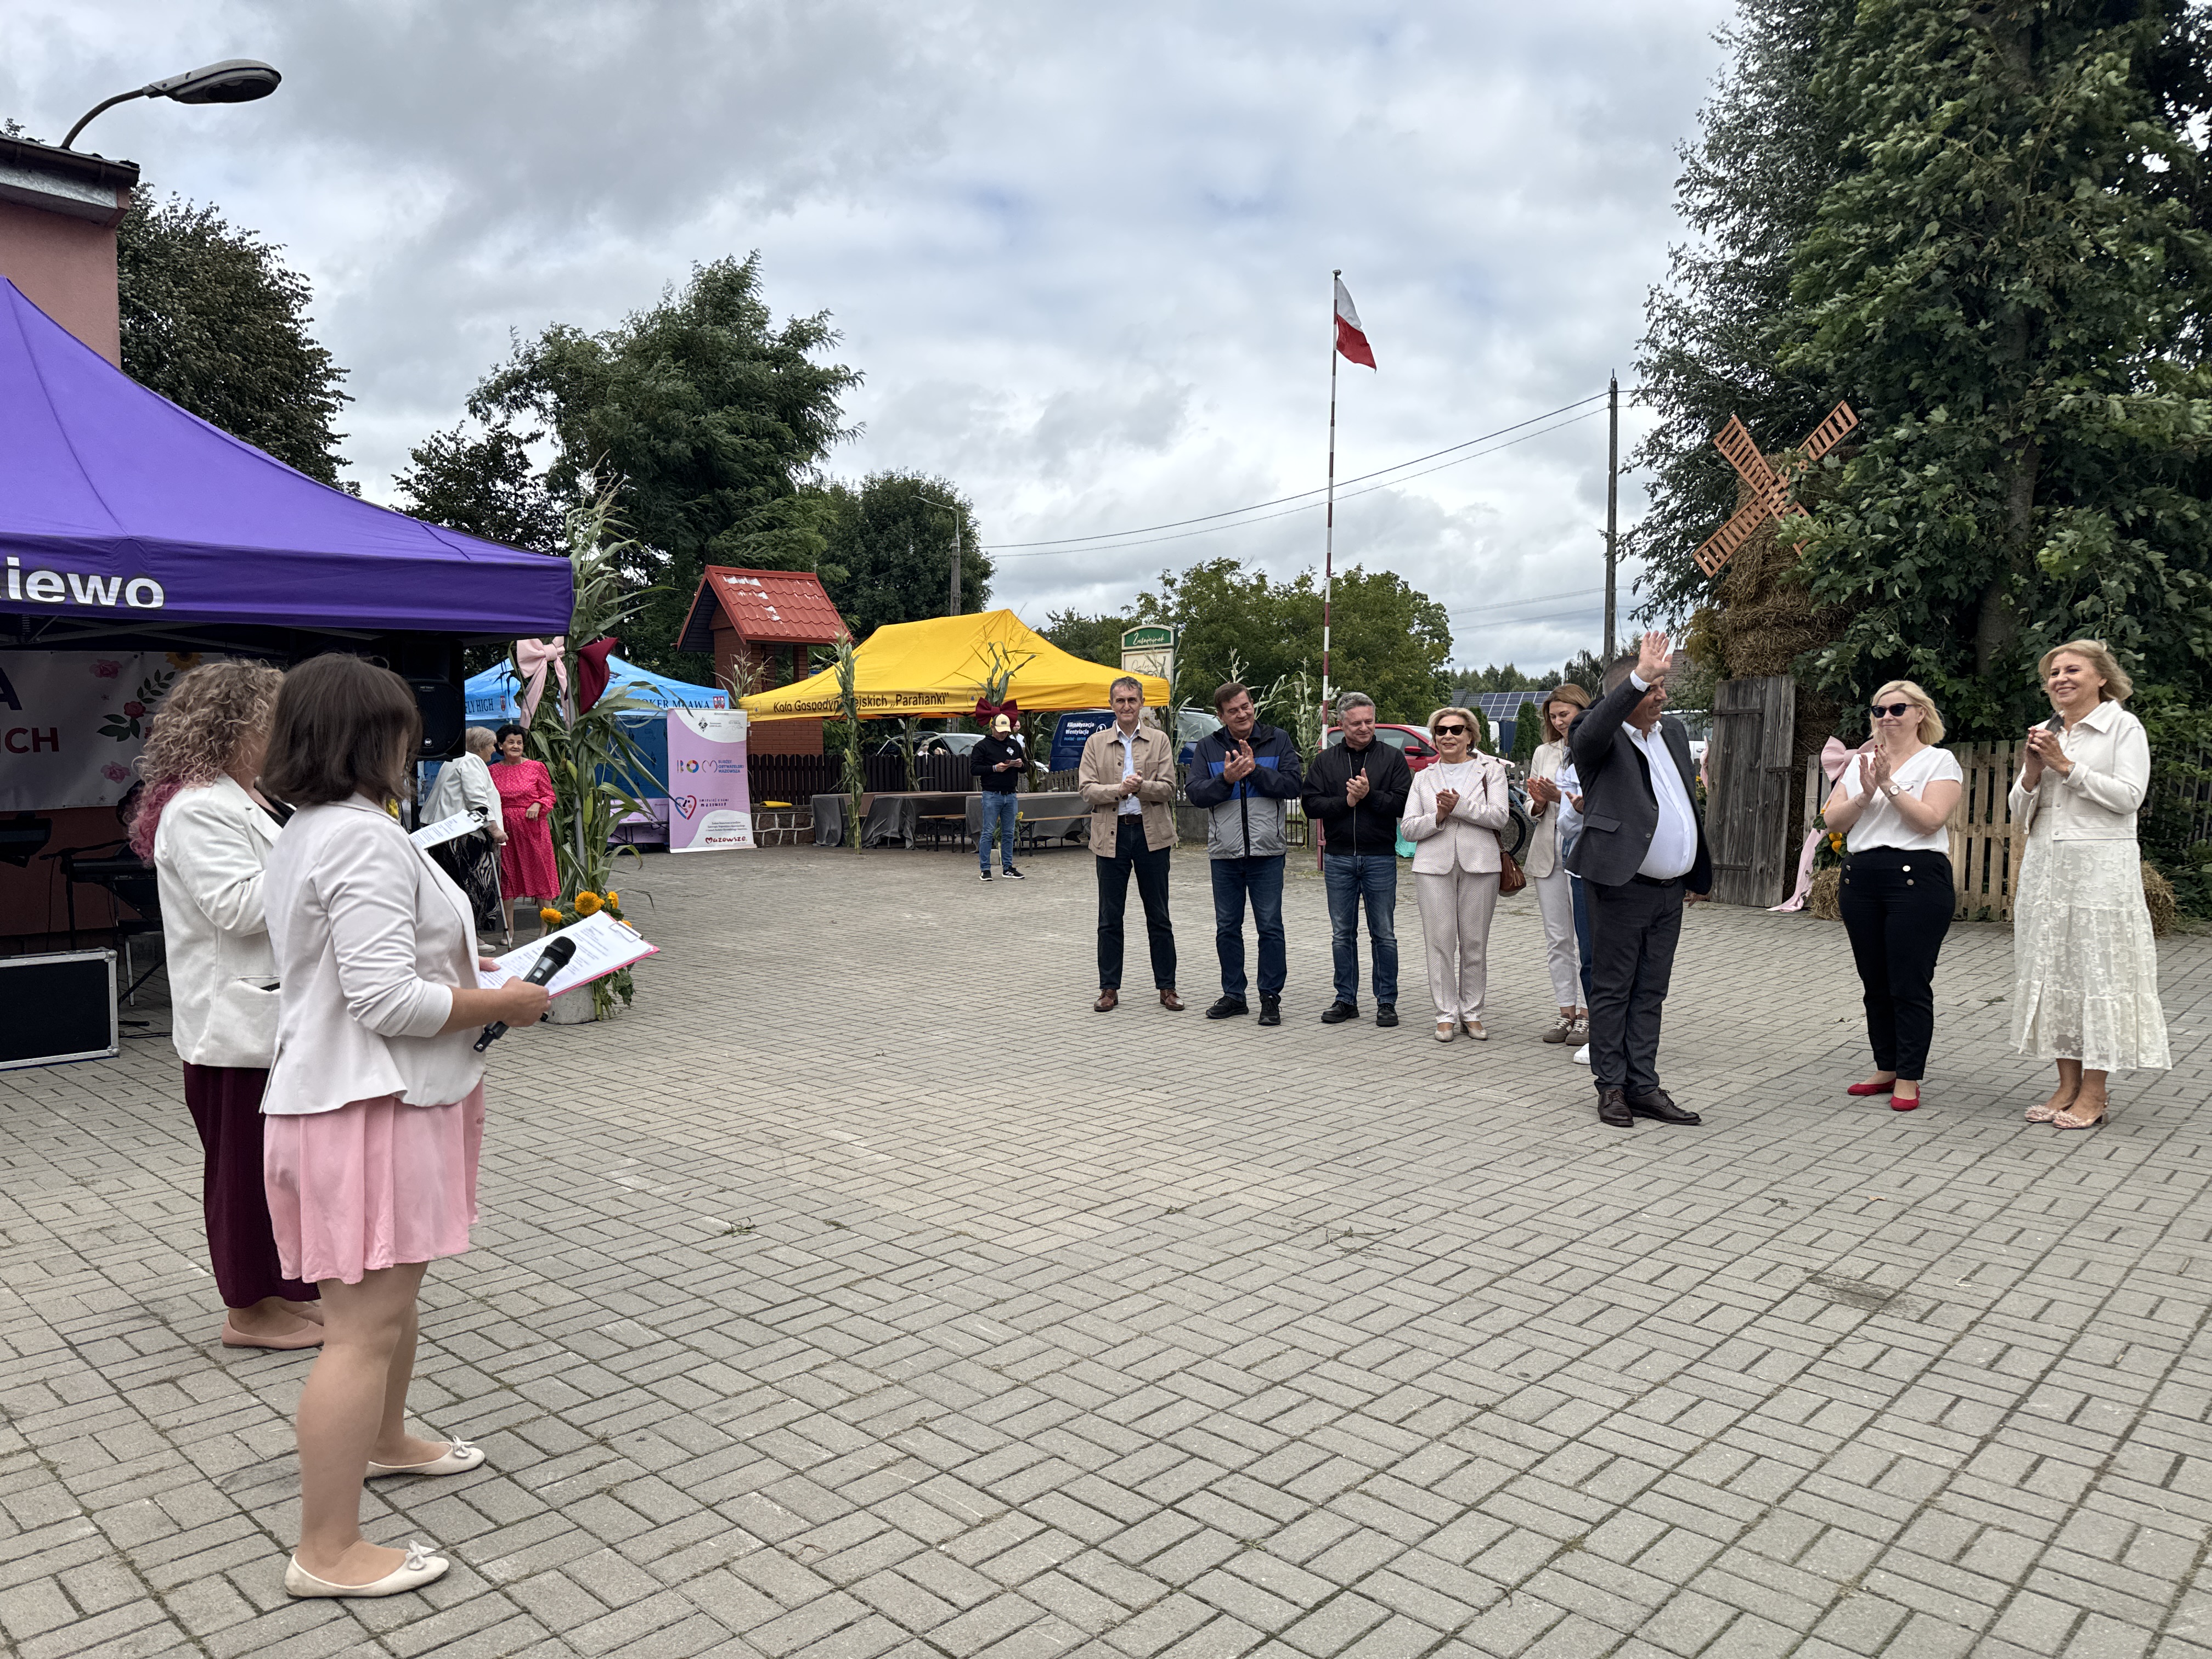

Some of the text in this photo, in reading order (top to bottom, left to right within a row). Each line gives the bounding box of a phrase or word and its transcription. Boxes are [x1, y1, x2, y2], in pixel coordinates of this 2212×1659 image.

[0, 556, 164, 608] iewo
[476, 698, 494, 712] HIGH
[774, 701, 792, 713] Koło
[0, 727, 59, 754] CH
